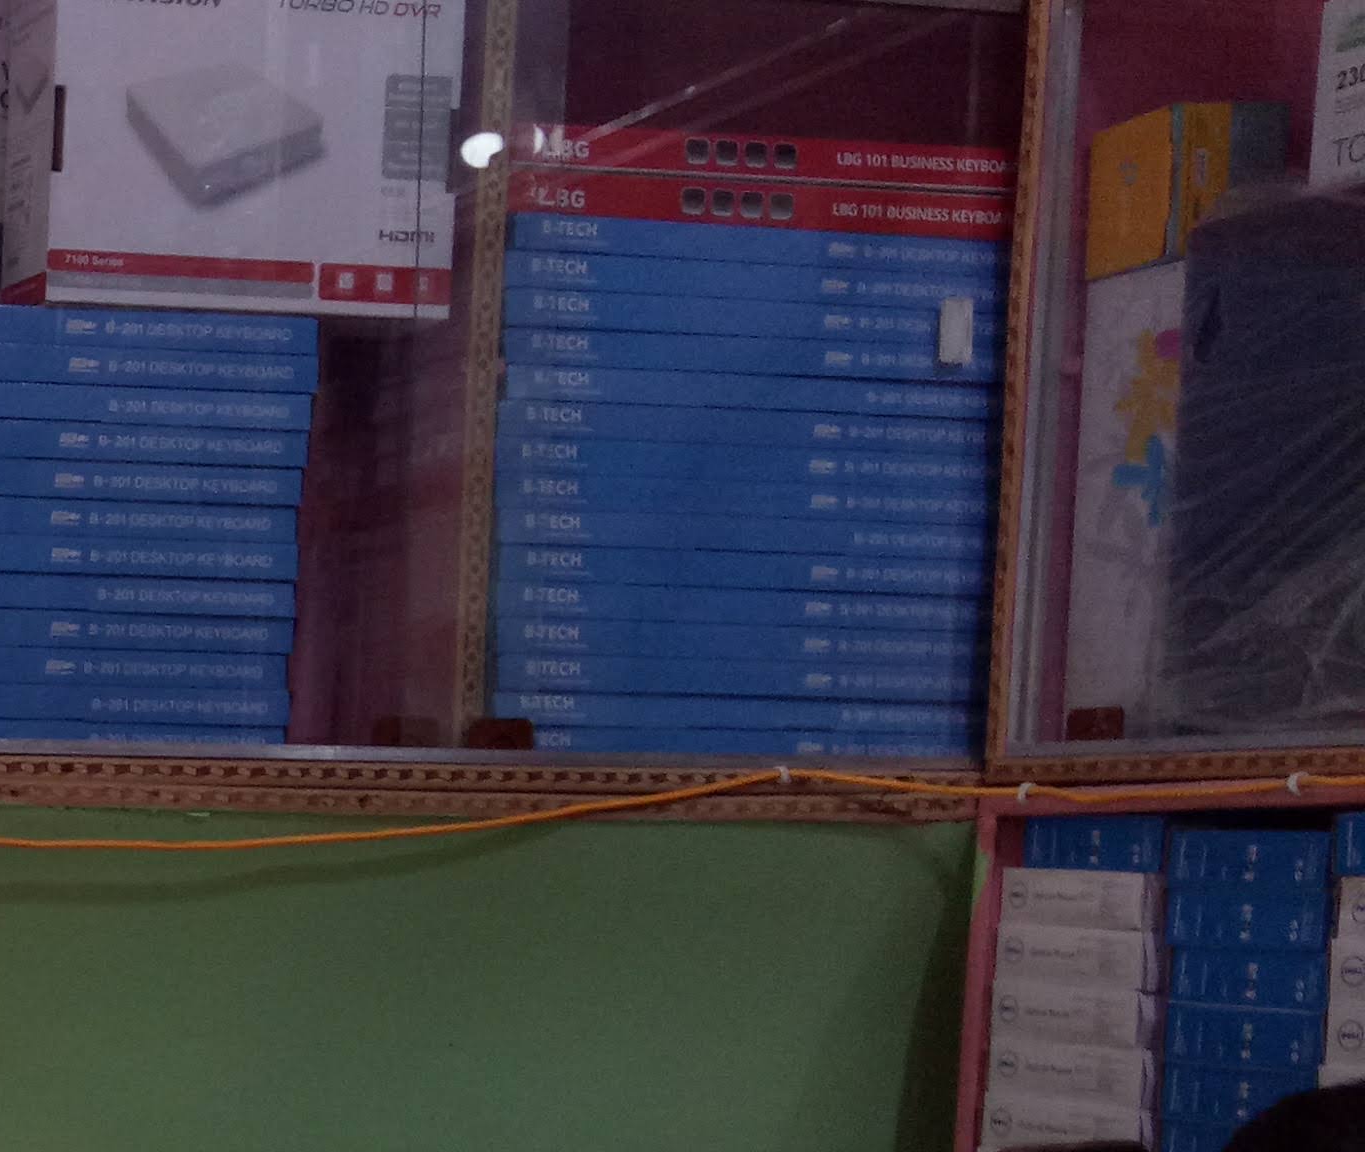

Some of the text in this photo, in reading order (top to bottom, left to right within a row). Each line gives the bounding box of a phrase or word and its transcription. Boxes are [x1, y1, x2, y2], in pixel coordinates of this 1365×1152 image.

[393, 2, 441, 17] DVR
[837, 151, 1011, 173] LBG 101 BUSINESS KEYBOA
[833, 203, 1007, 225] LBG 101 BUSINESS KEYBOA
[379, 229, 435, 243] HDMI
